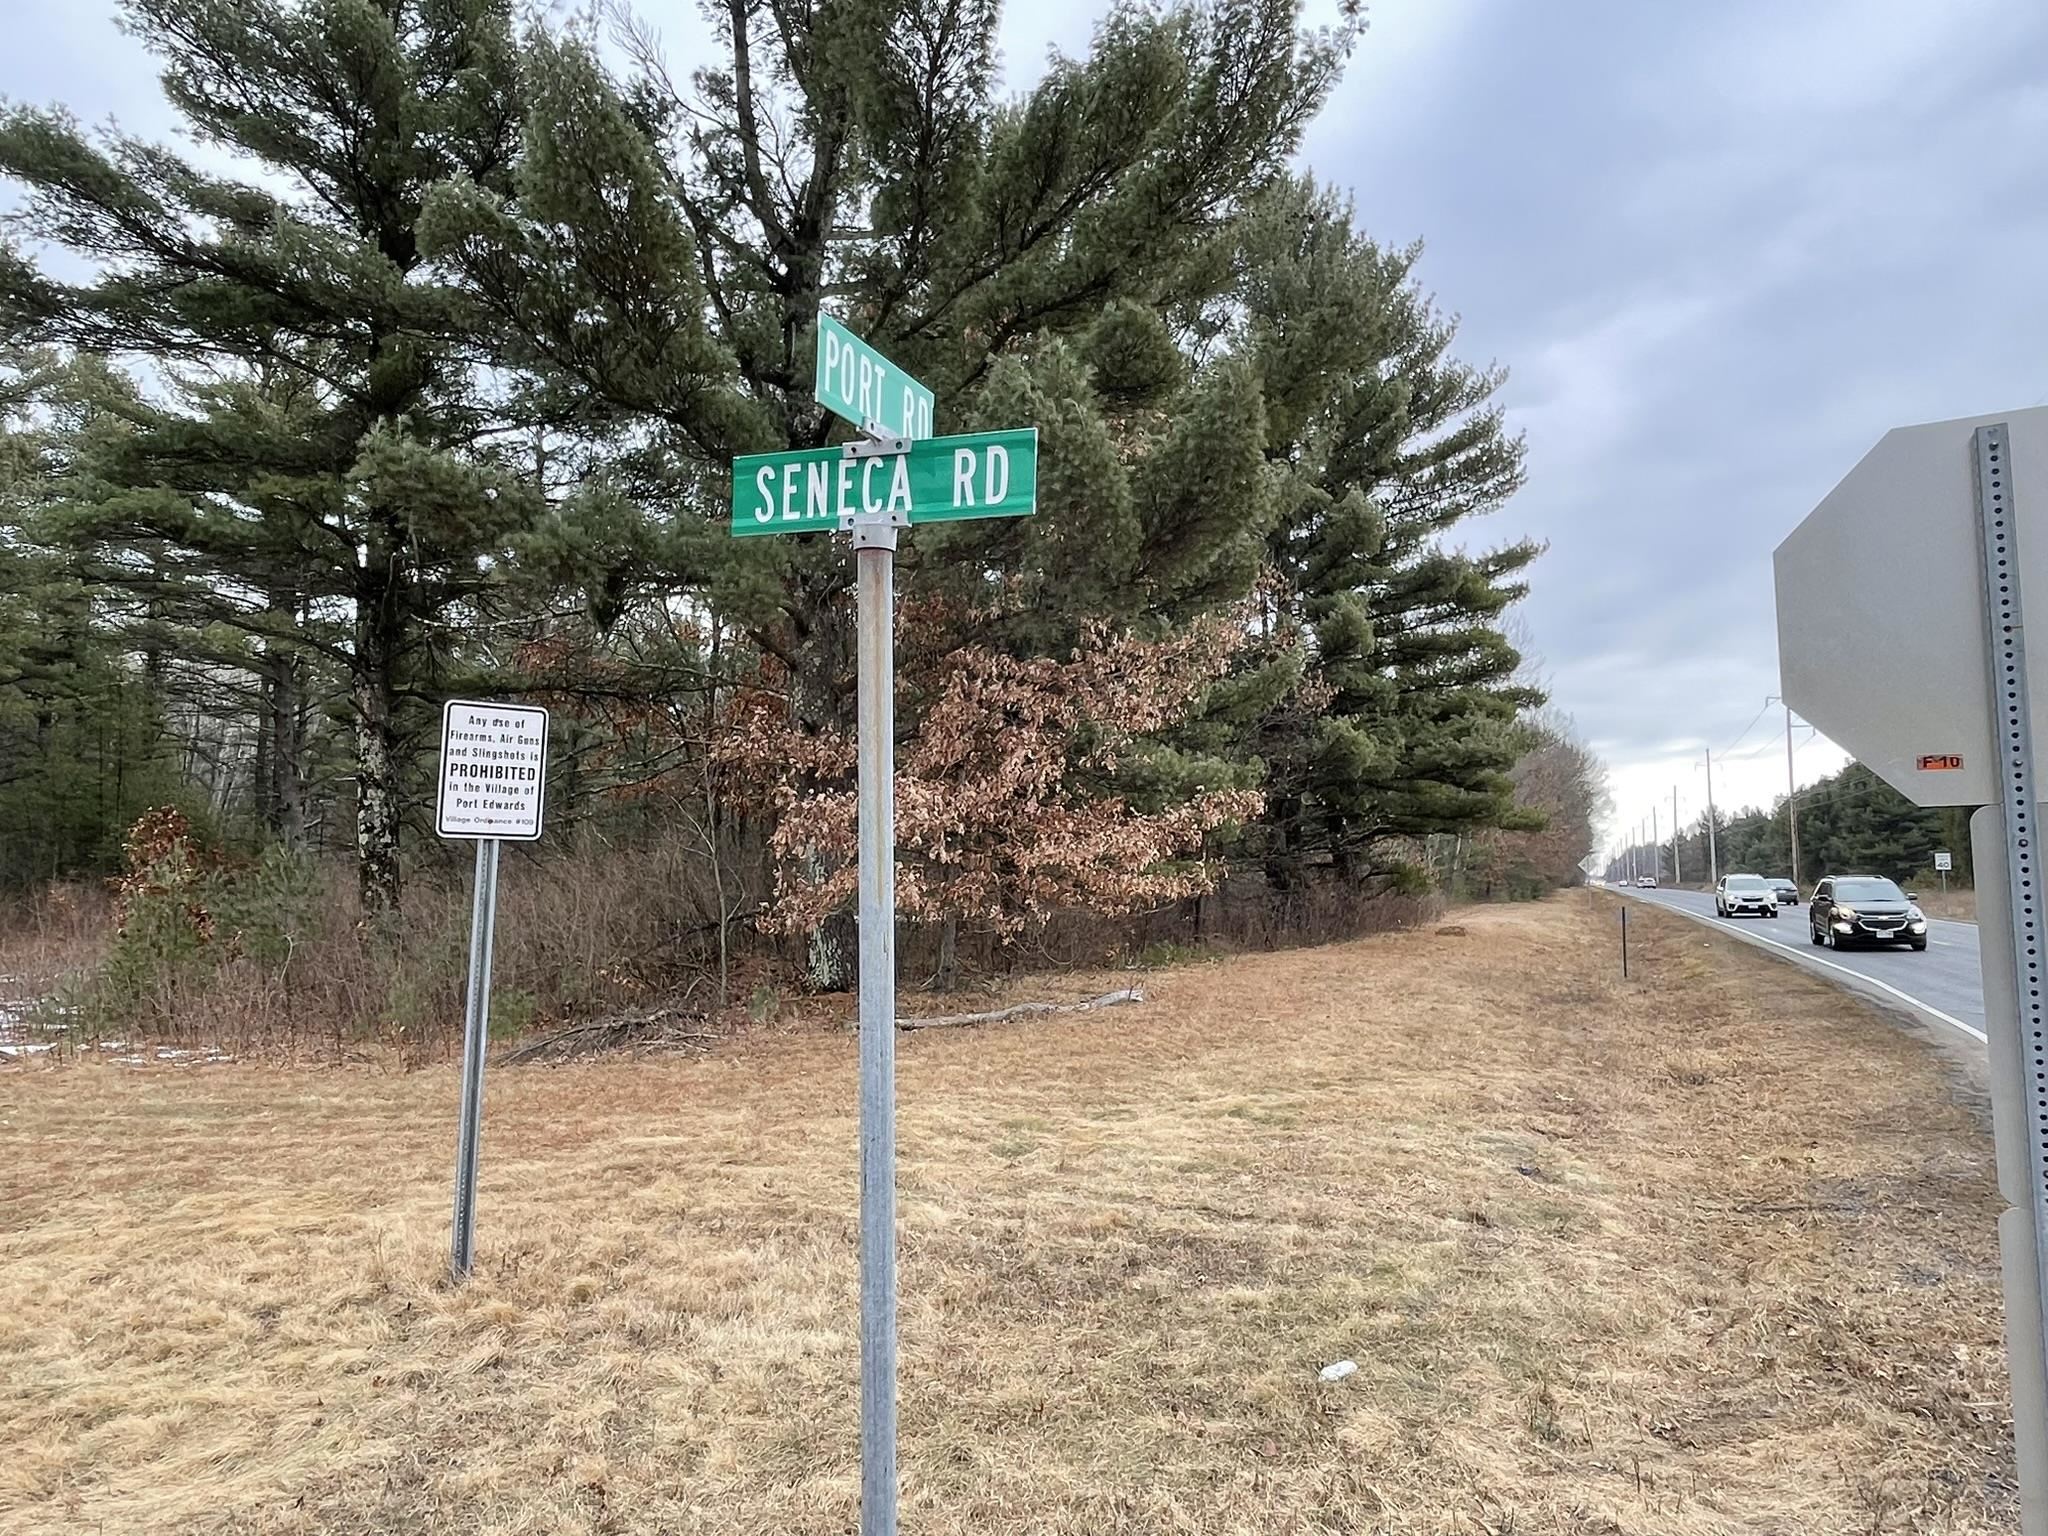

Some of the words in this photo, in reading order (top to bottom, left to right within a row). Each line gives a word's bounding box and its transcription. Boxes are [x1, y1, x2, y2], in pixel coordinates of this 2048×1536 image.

[824, 329, 885, 424] PORT
[902, 385, 929, 440] RD
[754, 454, 913, 523] SENECA
[952, 445, 1009, 507] RD
[468, 715, 487, 727] Any
[514, 719, 525, 729] of
[450, 730, 495, 743] Firearms,
[499, 734, 513, 744] Air
[517, 735, 540, 745] Guns
[449, 747, 468, 757] and
[472, 747, 525, 760] Slingshots
[530, 752, 539, 761] is
[450, 762, 536, 781] PROHIBITED
[449, 781, 459, 791] in
[464, 782, 480, 793] the
[485, 783, 519, 796] Village
[524, 786, 534, 795] of
[456, 798, 478, 809] Port
[483, 799, 525, 811] Edwards
[445, 815, 471, 824] Village
